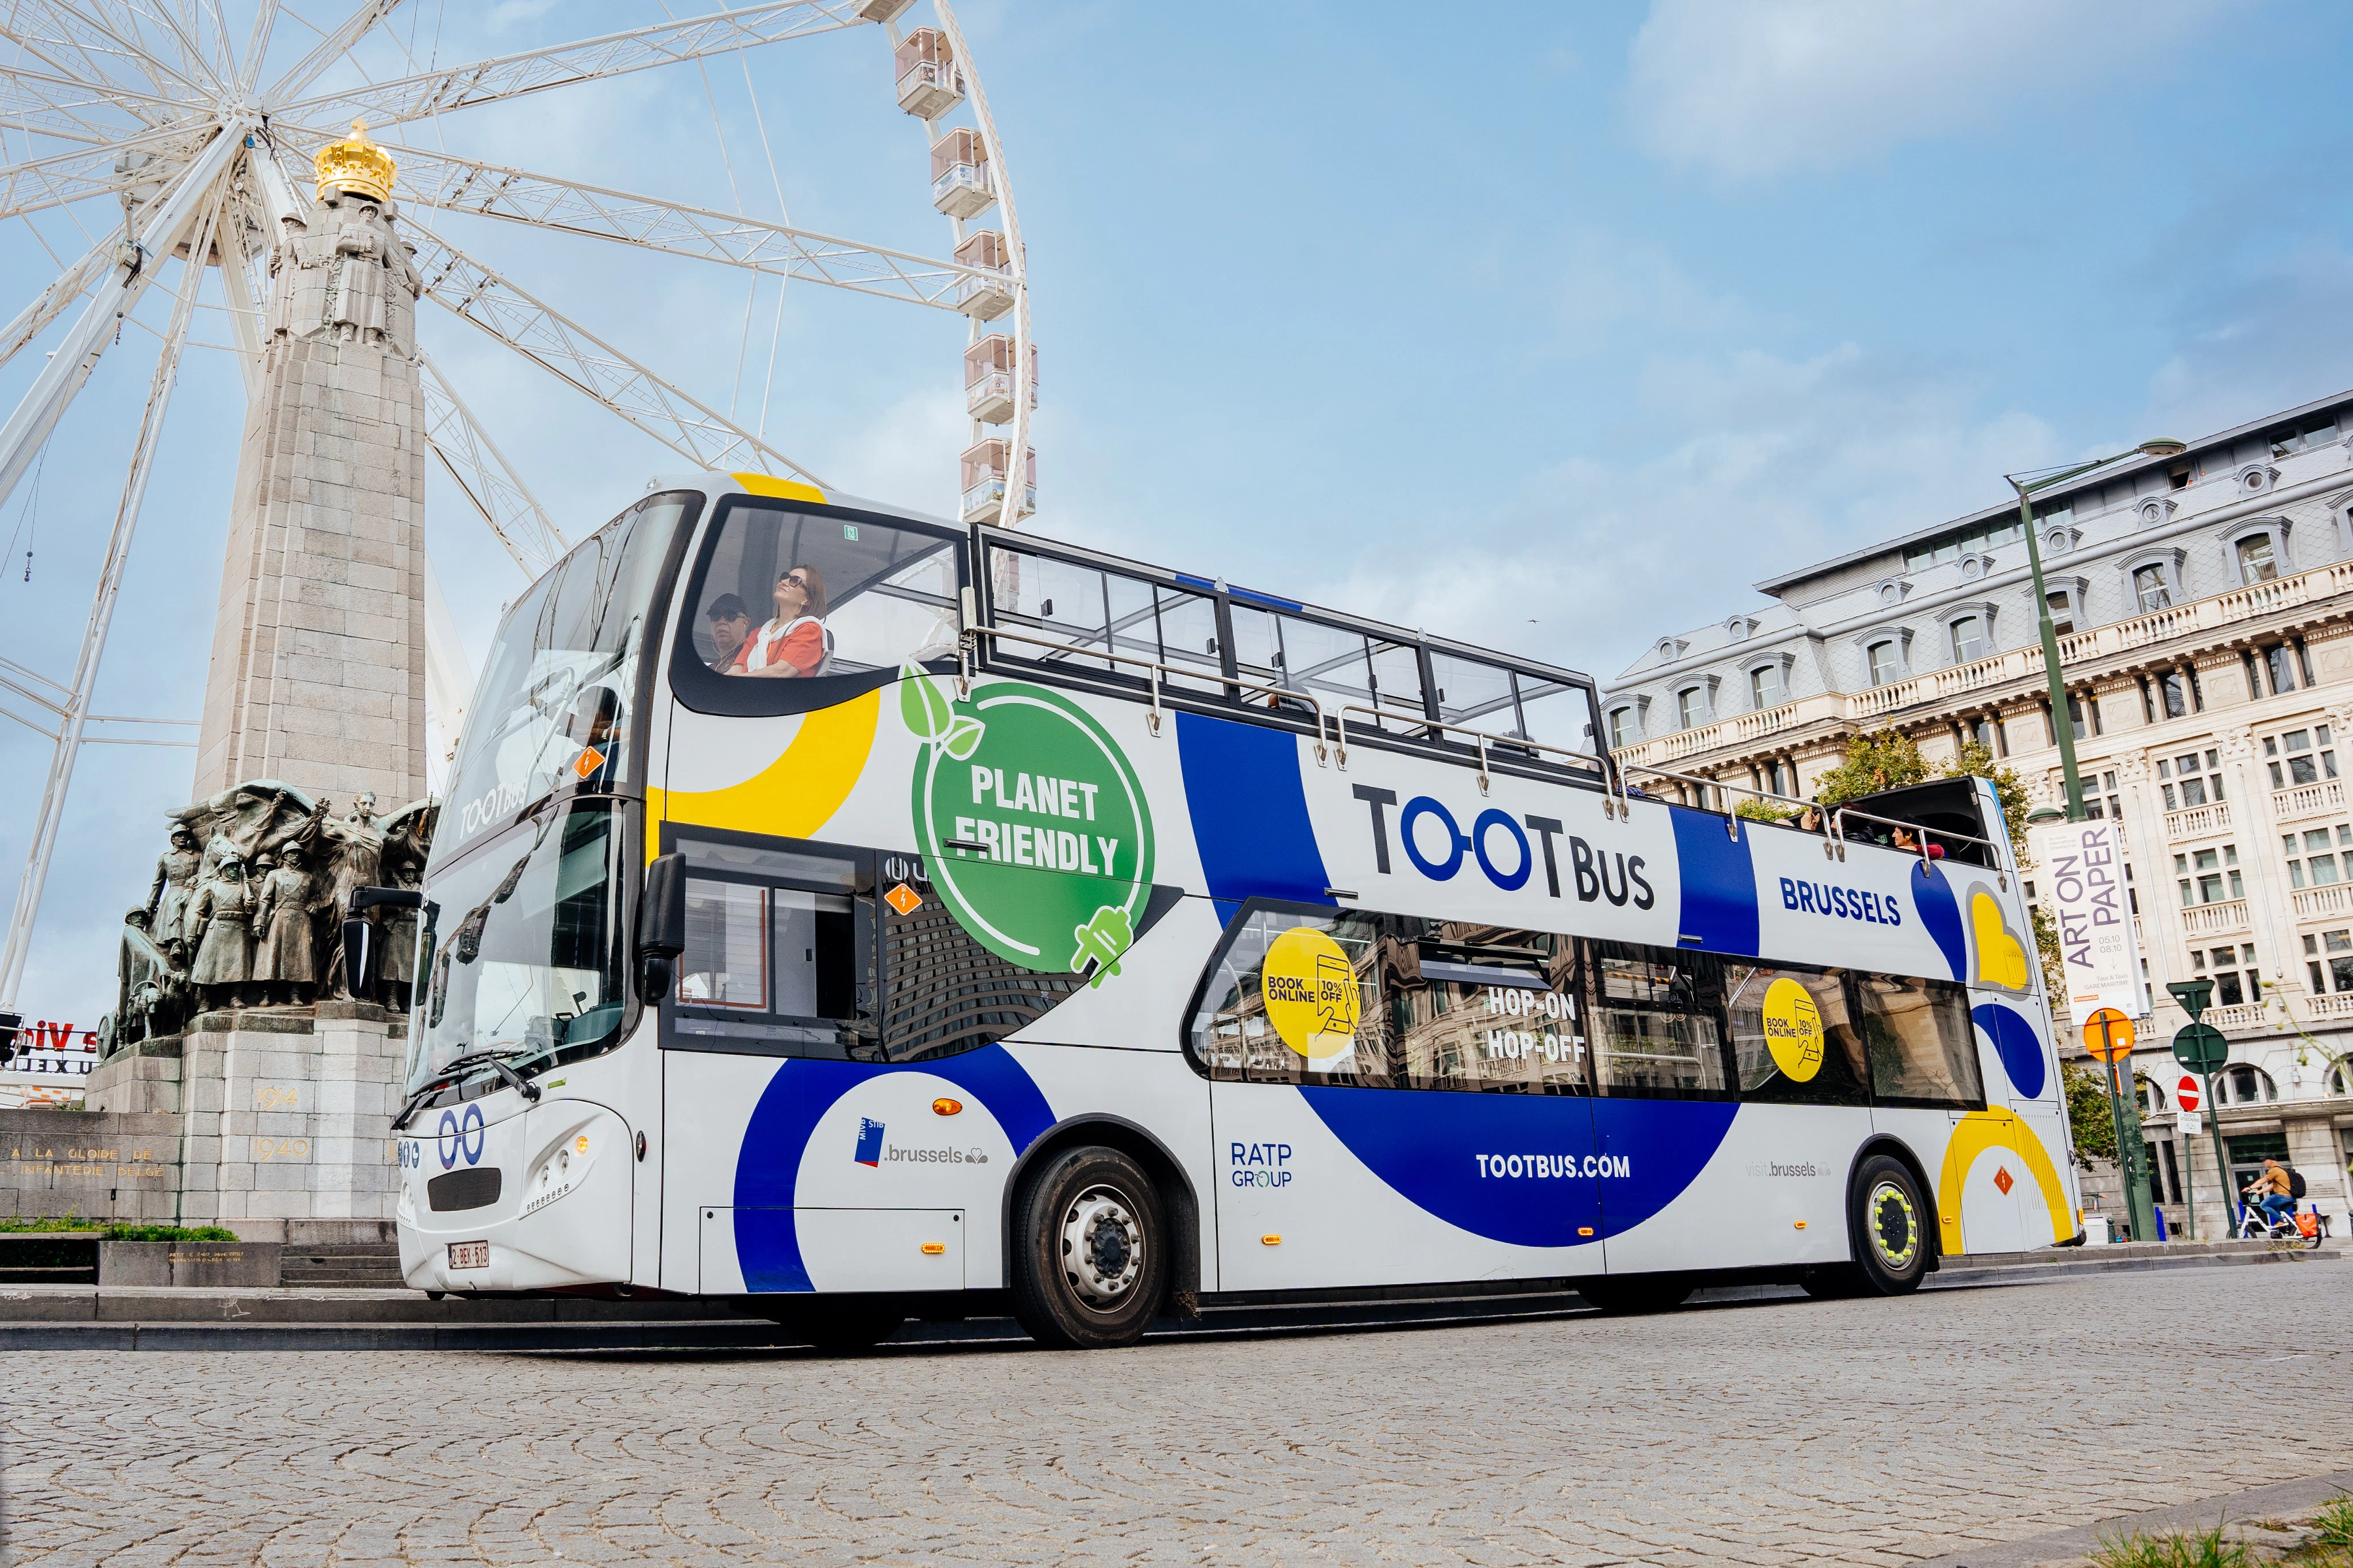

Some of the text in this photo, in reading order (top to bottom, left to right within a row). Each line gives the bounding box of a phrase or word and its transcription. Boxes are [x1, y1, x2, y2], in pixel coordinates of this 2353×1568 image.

[971, 764, 1098, 821] PLANET
[955, 816, 1118, 876] FRIENDLY
[2082, 826, 2120, 926] PAPER
[1779, 876, 1901, 926] BRUSSELS
[2052, 855, 2094, 968] ART ON
[2099, 935, 2120, 944] 05.10
[2100, 944, 2121, 953] 08.10
[1268, 976, 1305, 990] BOOK
[1322, 980, 1343, 993] 10%
[2101, 980, 2129, 988] MARITIME
[1269, 988, 1316, 1003] ONLINE
[1321, 991, 1342, 1003] OFF
[1488, 986, 1576, 1020] HOP-ON
[1766, 1018, 1789, 1028] BOOK
[1799, 1019, 1812, 1029] 10%
[1768, 1028, 1796, 1038] ONLINE
[1799, 1028, 1812, 1037] OFF
[1487, 1030, 1585, 1062] HOP-OFF
[258, 1087, 298, 1110] 1914
[11, 1148, 153, 1160] A LA GLOIRE DE
[254, 1139, 308, 1162] 1940
[1232, 1142, 1292, 1167] RATP
[21, 1165, 105, 1176] INFANTERIE
[117, 1167, 164, 1177] BELGE
[1476, 1154, 1630, 1177] TOOTBUS.COM
[1232, 1171, 1292, 1188] GROUP
